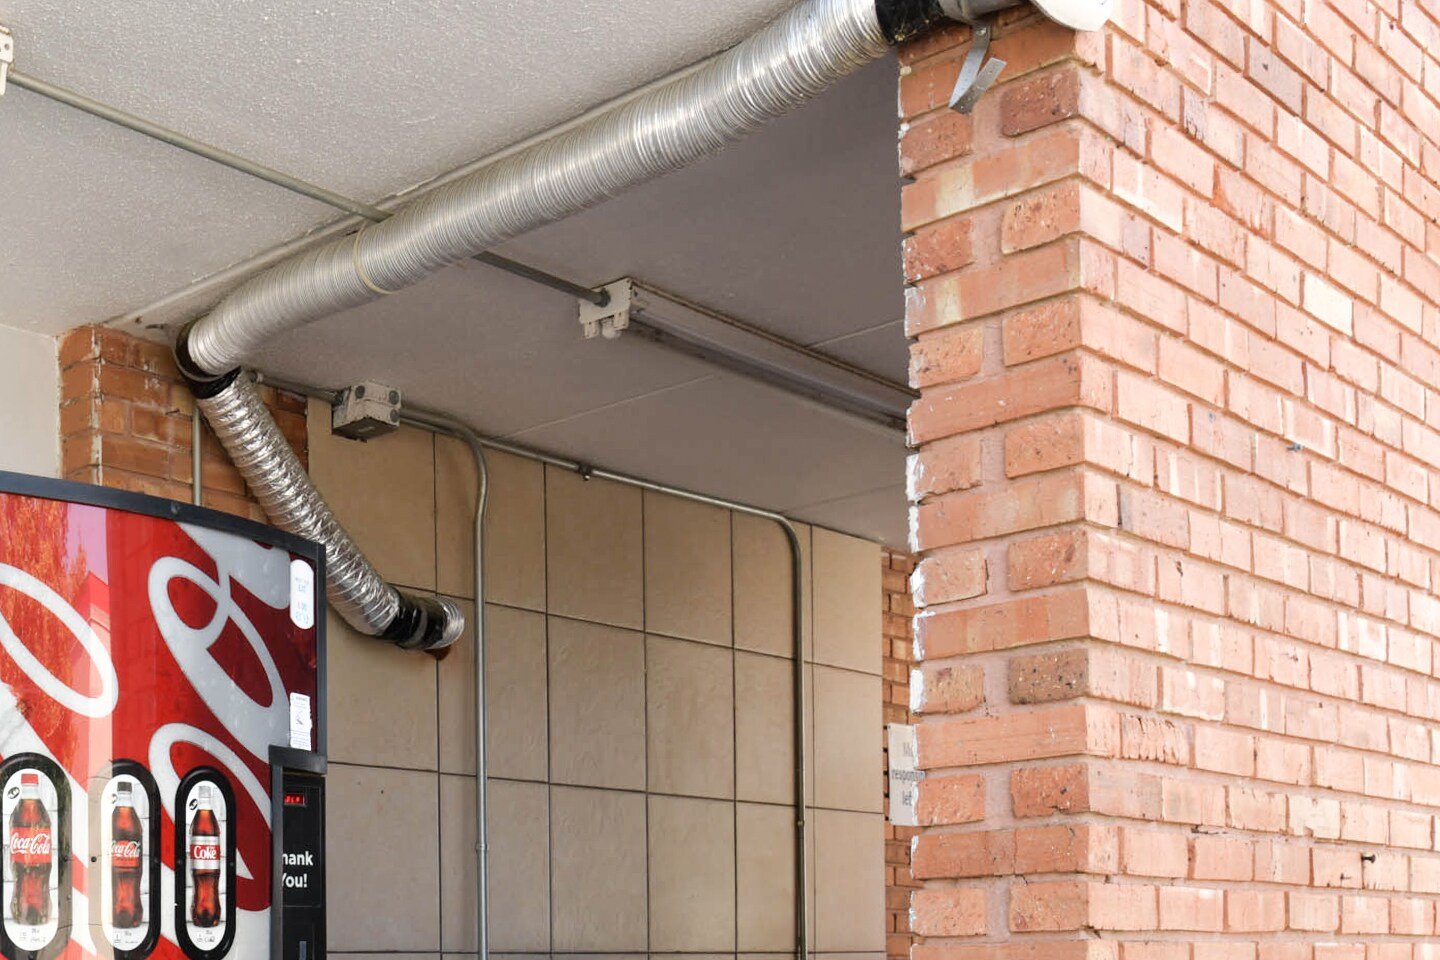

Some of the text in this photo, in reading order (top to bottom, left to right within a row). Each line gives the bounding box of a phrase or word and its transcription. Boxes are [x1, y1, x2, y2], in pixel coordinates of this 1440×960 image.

[9, 831, 51, 855] Coca-Cola
[193, 845, 217, 860] Coke
[282, 850, 314, 866] hank
